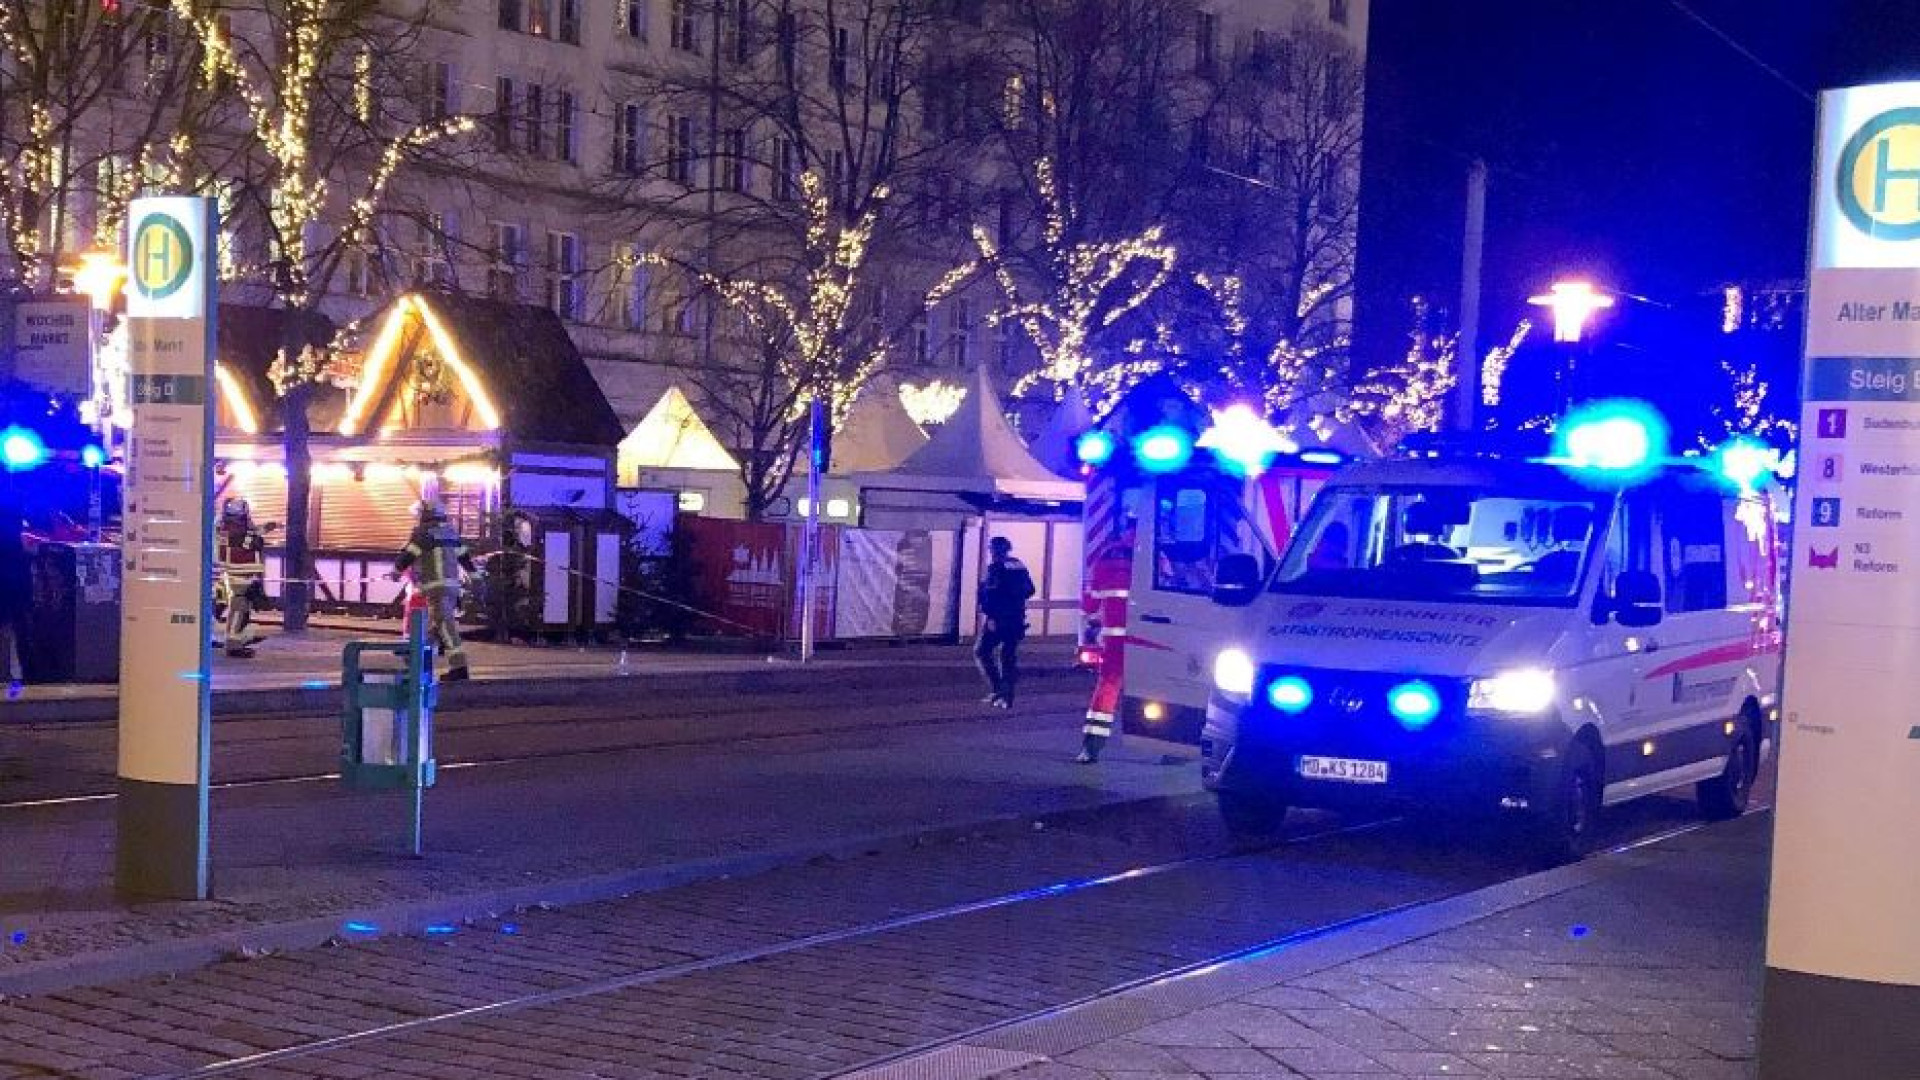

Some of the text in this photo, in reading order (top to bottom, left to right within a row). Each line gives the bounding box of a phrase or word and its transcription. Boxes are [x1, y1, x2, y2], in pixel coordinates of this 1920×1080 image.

[1874, 138, 1920, 212] H
[143, 231, 169, 281] H
[1837, 301, 1886, 322] Alter
[1850, 369, 1905, 394] Steig
[1822, 458, 1834, 478] 8
[1820, 502, 1832, 523] 9
[1329, 761, 1346, 776] KS
[1351, 762, 1384, 779] 1284
